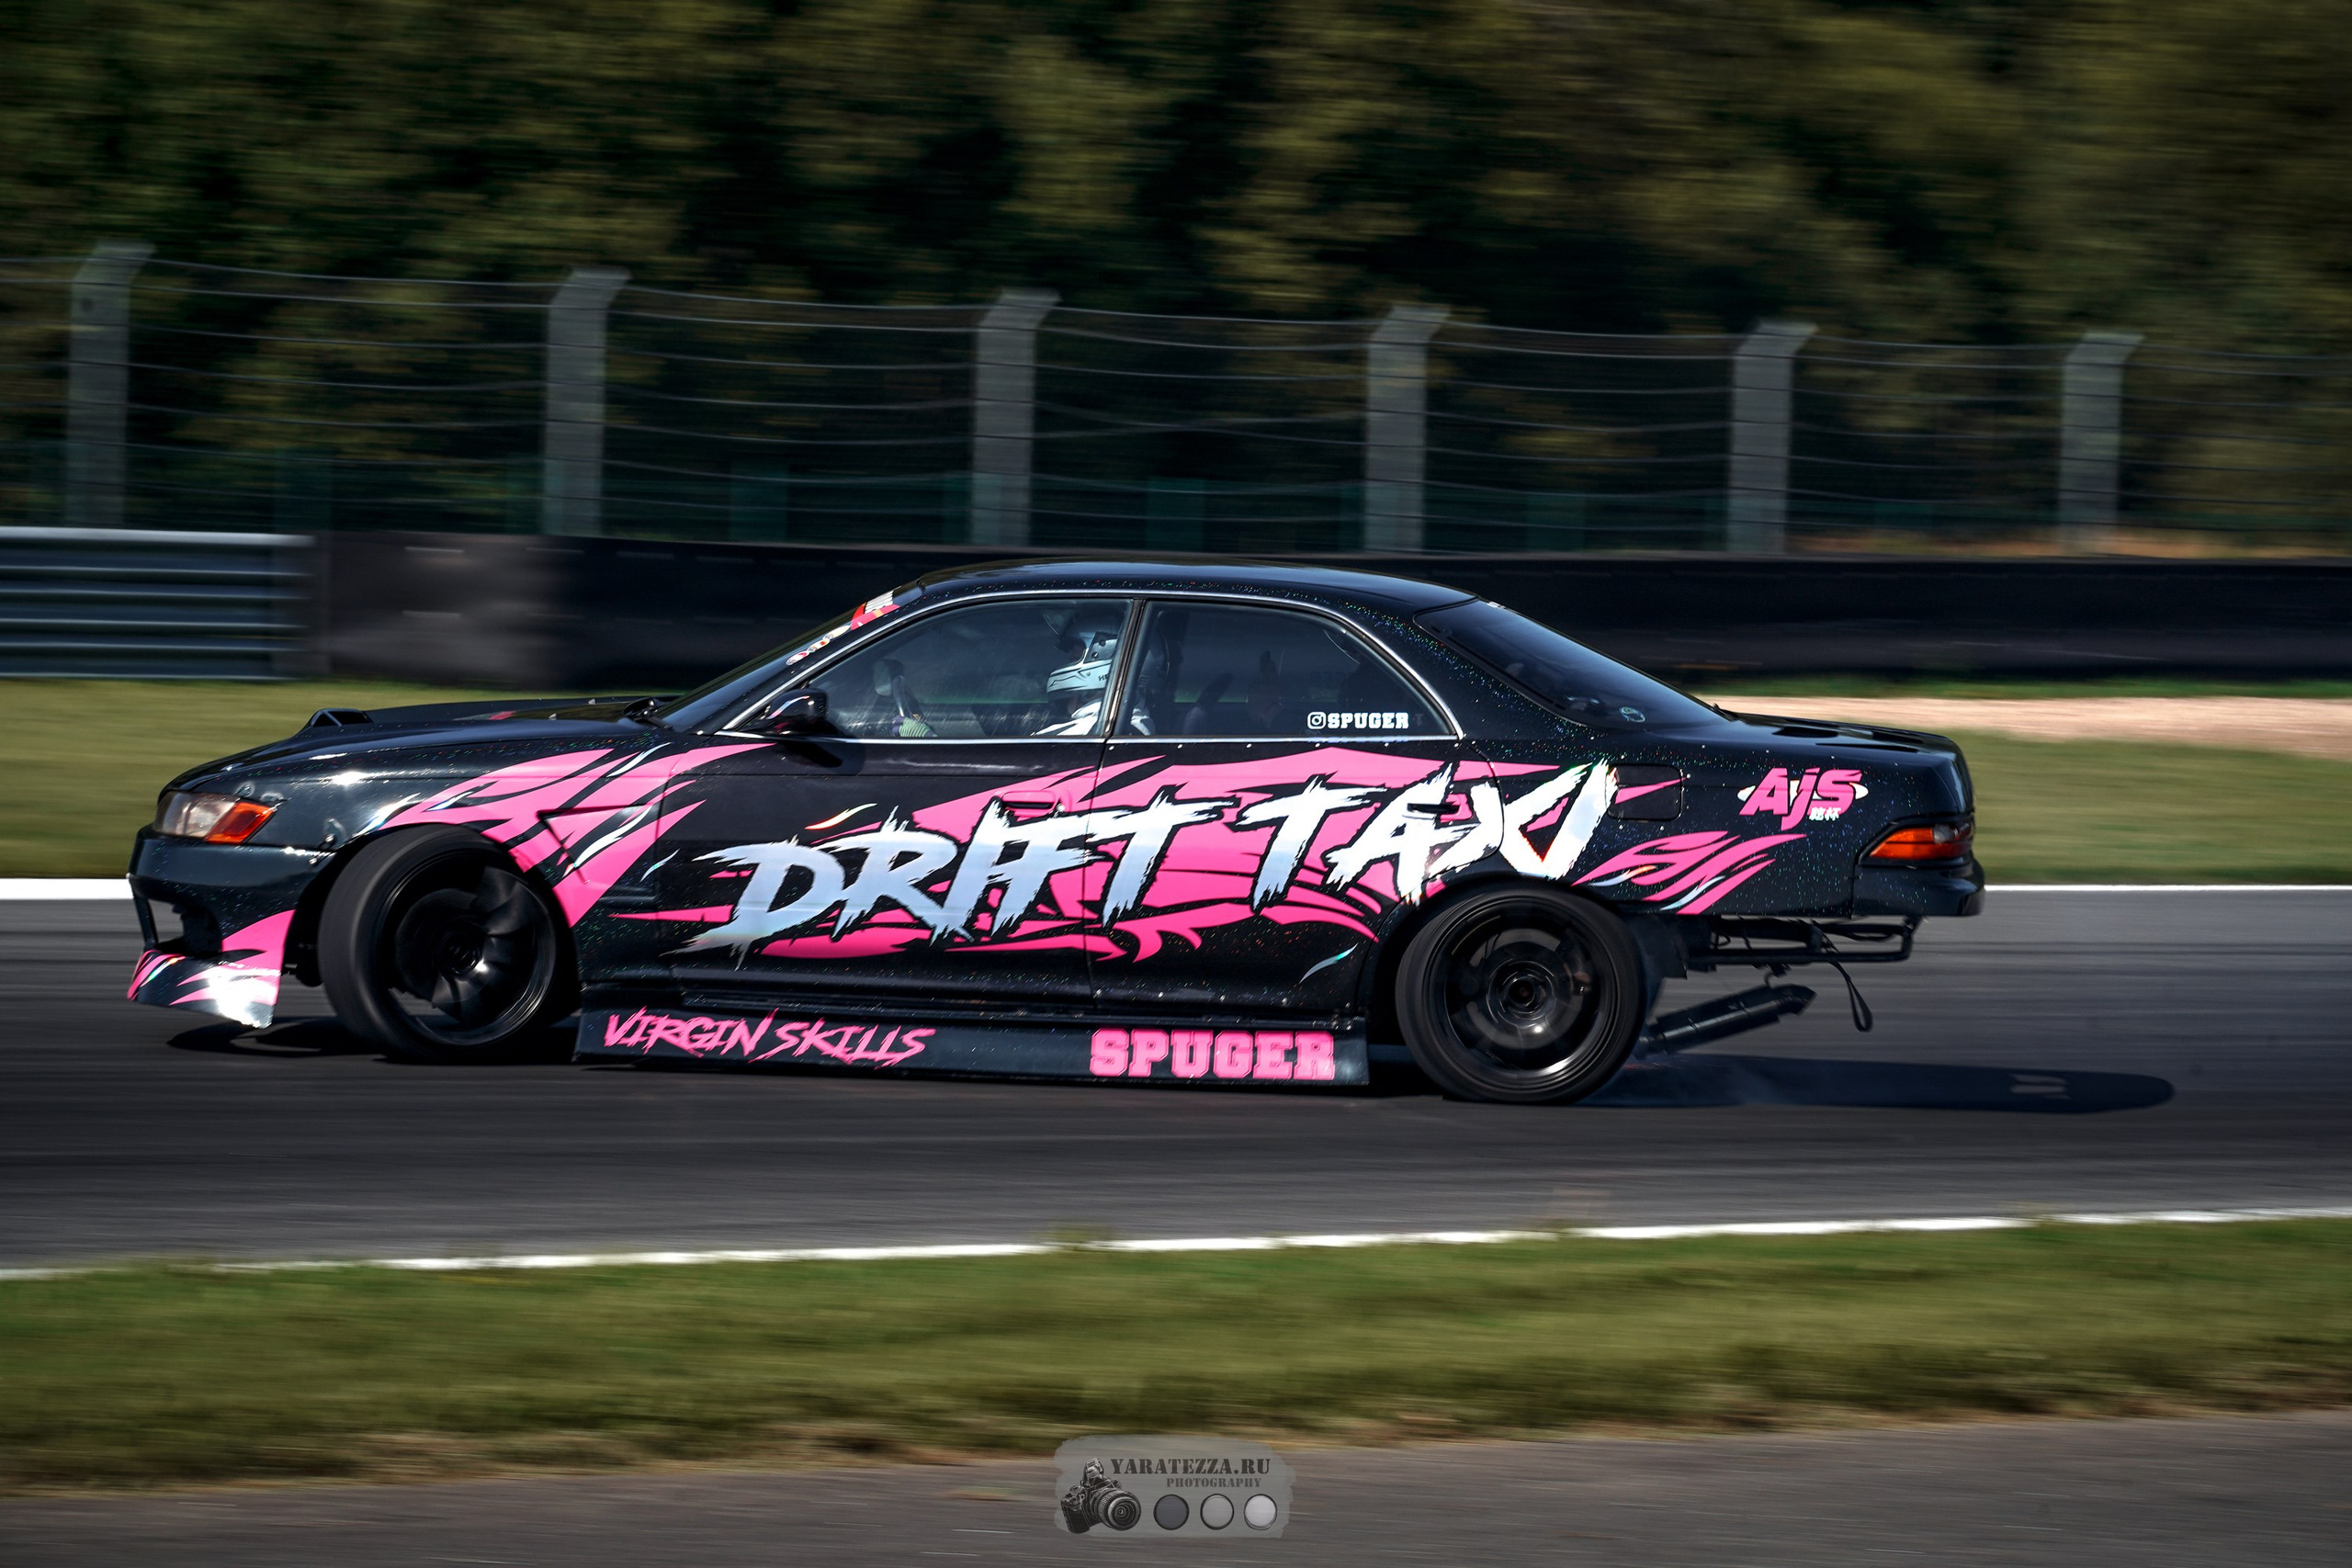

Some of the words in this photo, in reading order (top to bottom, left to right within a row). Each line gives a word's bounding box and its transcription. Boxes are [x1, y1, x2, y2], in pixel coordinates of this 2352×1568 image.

[1327, 712, 1409, 729] SPUGER
[659, 795, 1236, 970] DRIFT
[1236, 759, 1617, 912] TAXI
[603, 1006, 779, 1058] VIRGIN
[747, 1017, 936, 1070] SKILLS
[1089, 1027, 1336, 1080] SPUGER
